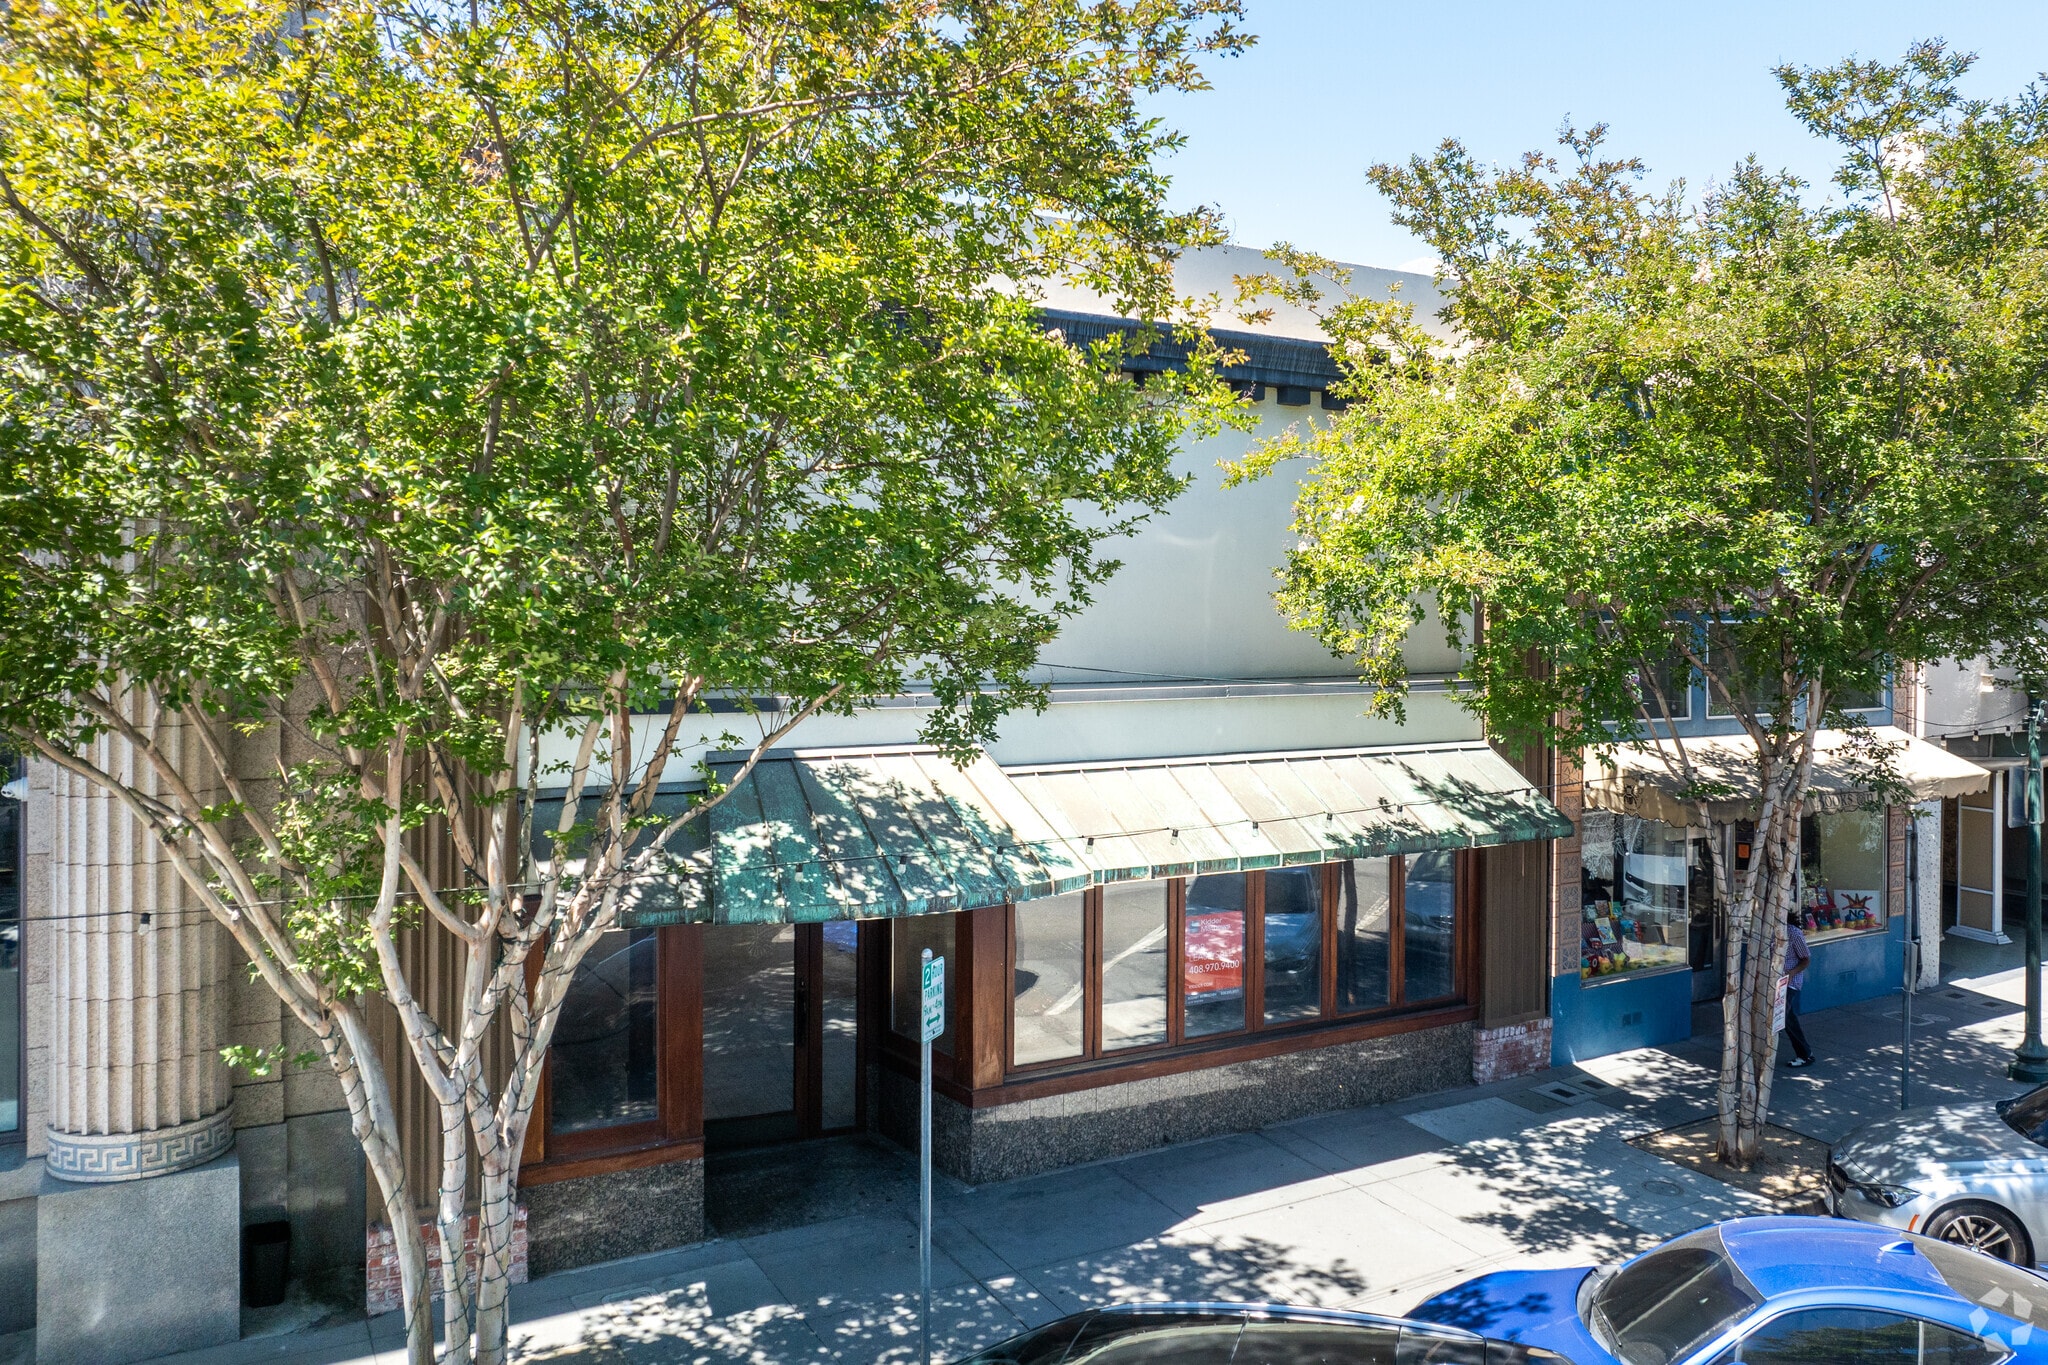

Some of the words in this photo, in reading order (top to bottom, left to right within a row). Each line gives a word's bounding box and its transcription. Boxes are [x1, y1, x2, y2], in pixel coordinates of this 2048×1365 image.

[1201, 918, 1222, 926] Kidder
[1189, 959, 1239, 974] 408.970.9400
[925, 967, 931, 985] 2
[924, 980, 943, 1001] PARKING
